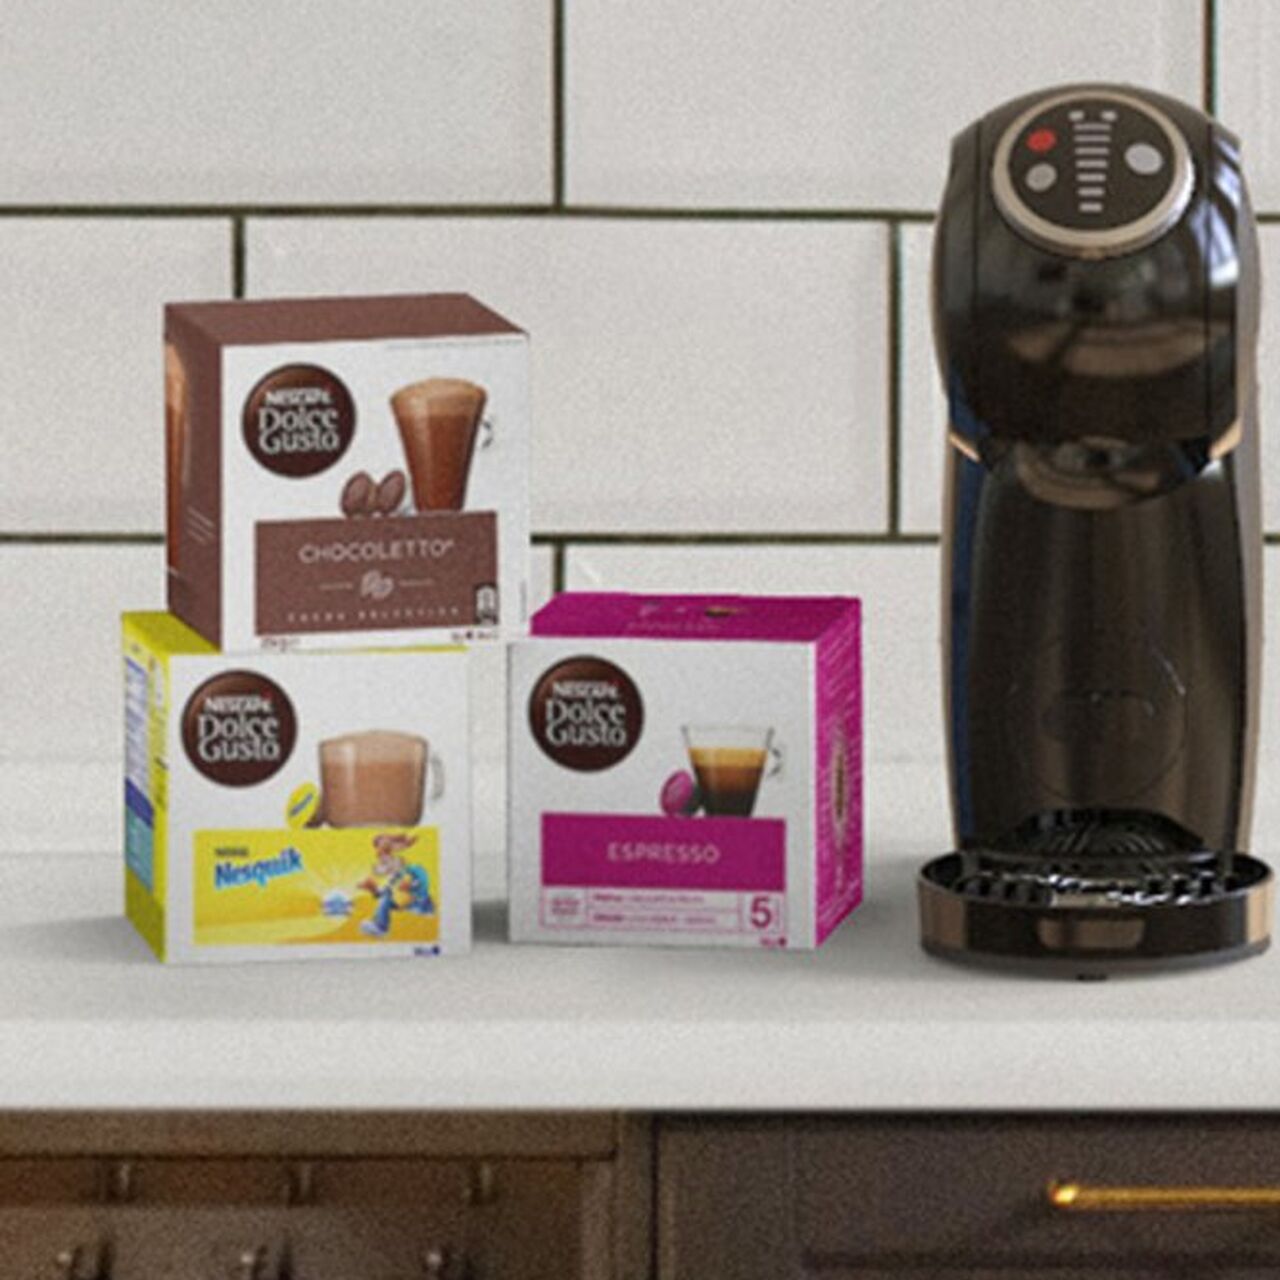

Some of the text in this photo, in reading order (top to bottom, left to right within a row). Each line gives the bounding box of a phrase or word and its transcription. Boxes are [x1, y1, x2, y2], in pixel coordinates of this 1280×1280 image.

[259, 429, 339, 454] Gusto
[546, 699, 627, 725] Dolce
[546, 722, 627, 748] Gusto
[198, 737, 279, 763] Gusto
[606, 841, 721, 865] ESPRESSO
[214, 846, 303, 890] Nesquik
[751, 895, 772, 930] 5
